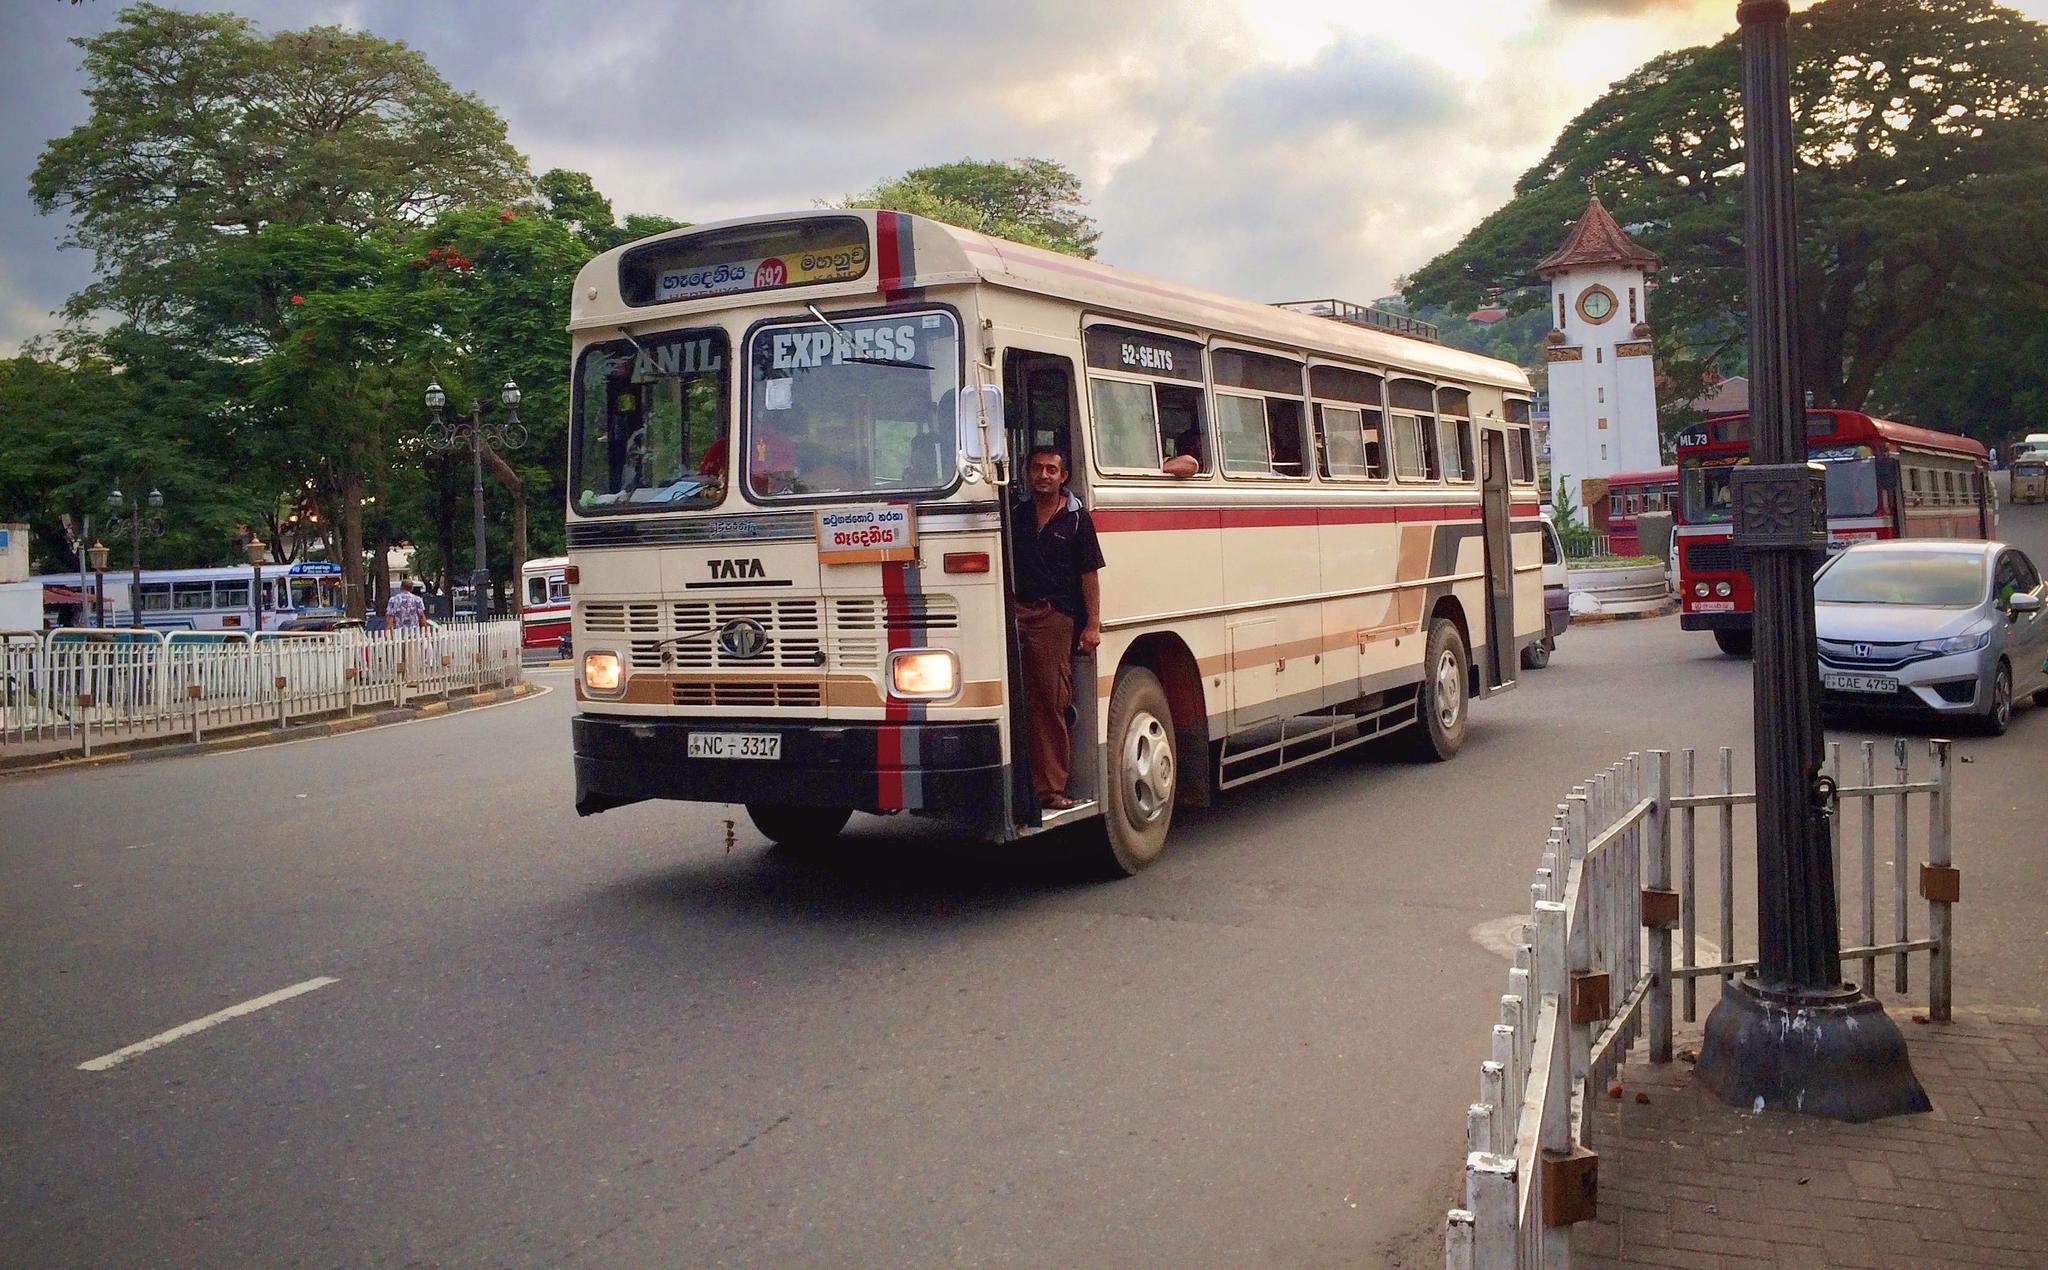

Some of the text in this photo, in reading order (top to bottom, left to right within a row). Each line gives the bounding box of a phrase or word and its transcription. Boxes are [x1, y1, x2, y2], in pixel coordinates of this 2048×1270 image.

[757, 266, 782, 288] 692
[773, 325, 915, 369] EXPRESS
[1122, 343, 1173, 371] 52-SEATS
[631, 339, 721, 383] ANIL
[1695, 434, 1707, 445] 73
[707, 559, 766, 579] TATA
[1838, 677, 1896, 691] CAE 4755
